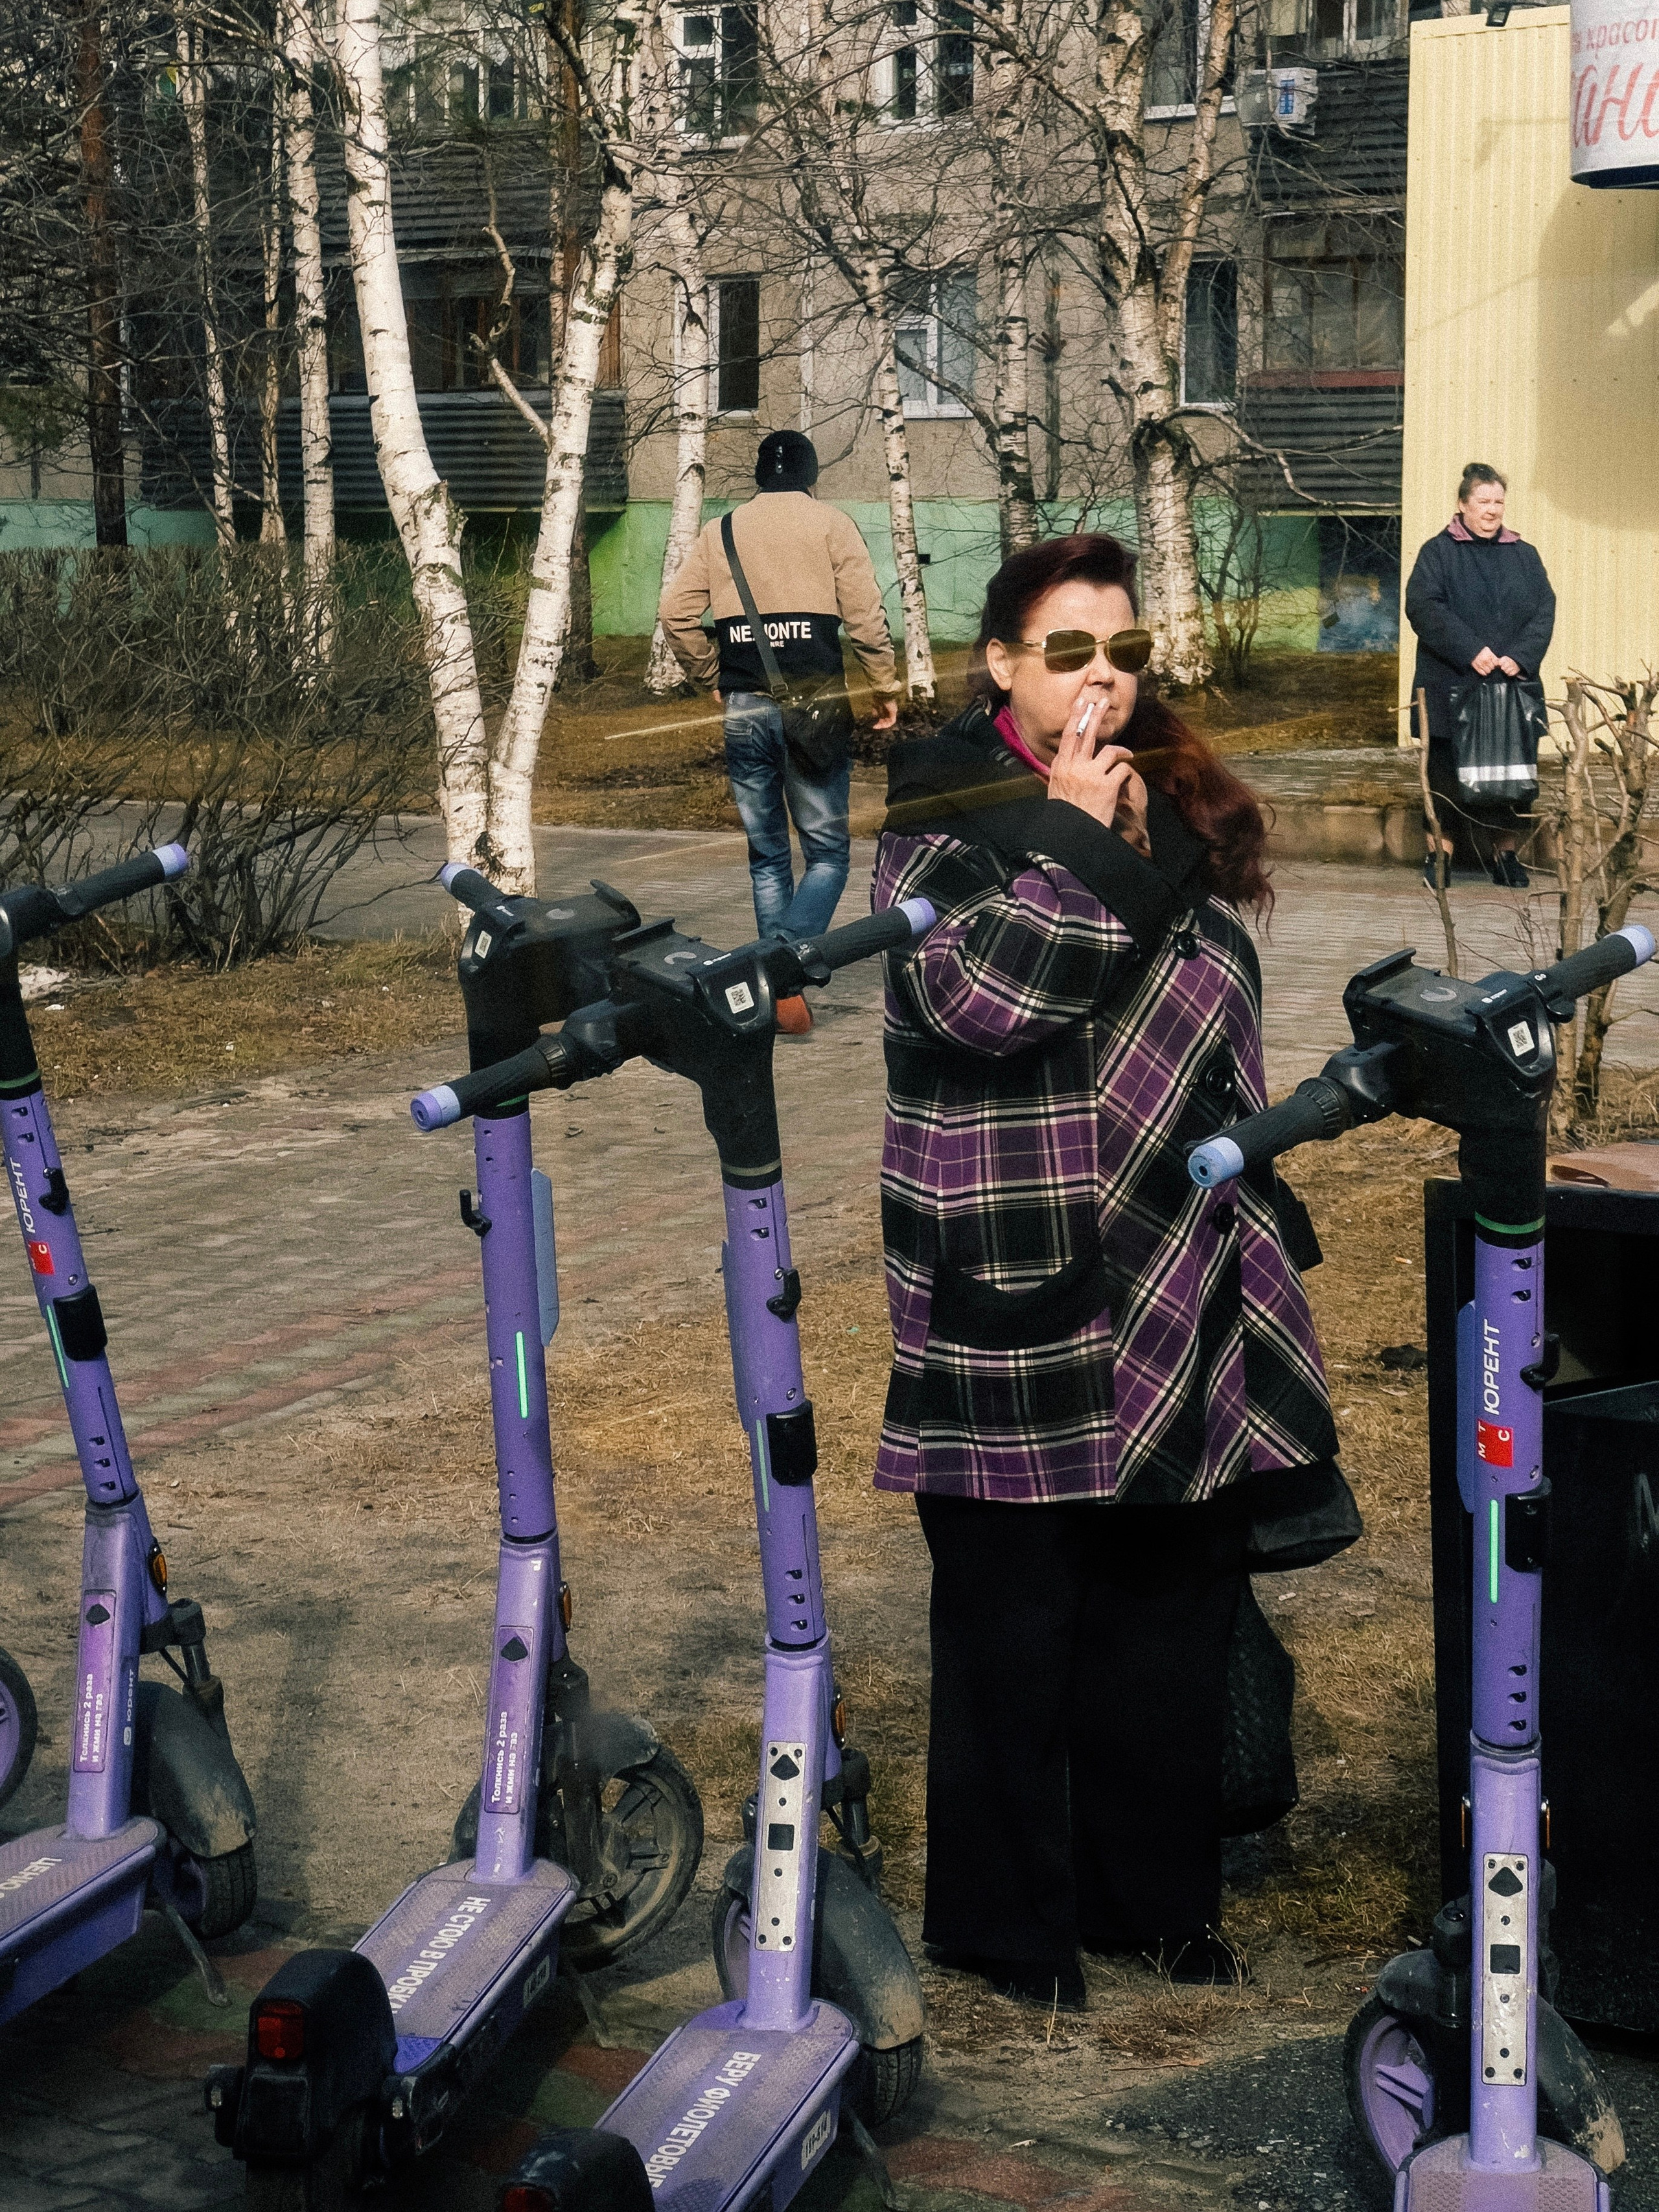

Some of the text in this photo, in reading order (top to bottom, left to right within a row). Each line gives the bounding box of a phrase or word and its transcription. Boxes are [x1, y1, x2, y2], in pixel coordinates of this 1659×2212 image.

[730, 622, 812, 643] NEONTE
[10, 1157, 36, 1233] ЮРЕНТ
[1483, 1319, 1501, 1415] ЮРЕНТ
[84, 1701, 92, 1710] 2
[95, 1712, 102, 1727] на
[80, 1711, 91, 1762] Толкнись
[491, 1712, 507, 1804] Толкнись 2 раза
[508, 1752, 516, 1767] на
[506, 1767, 515, 1795] жми
[388, 1896, 491, 2014] НЕ СТОЮ В ПРОБК
[715, 2051, 761, 2087] БЕРУ
